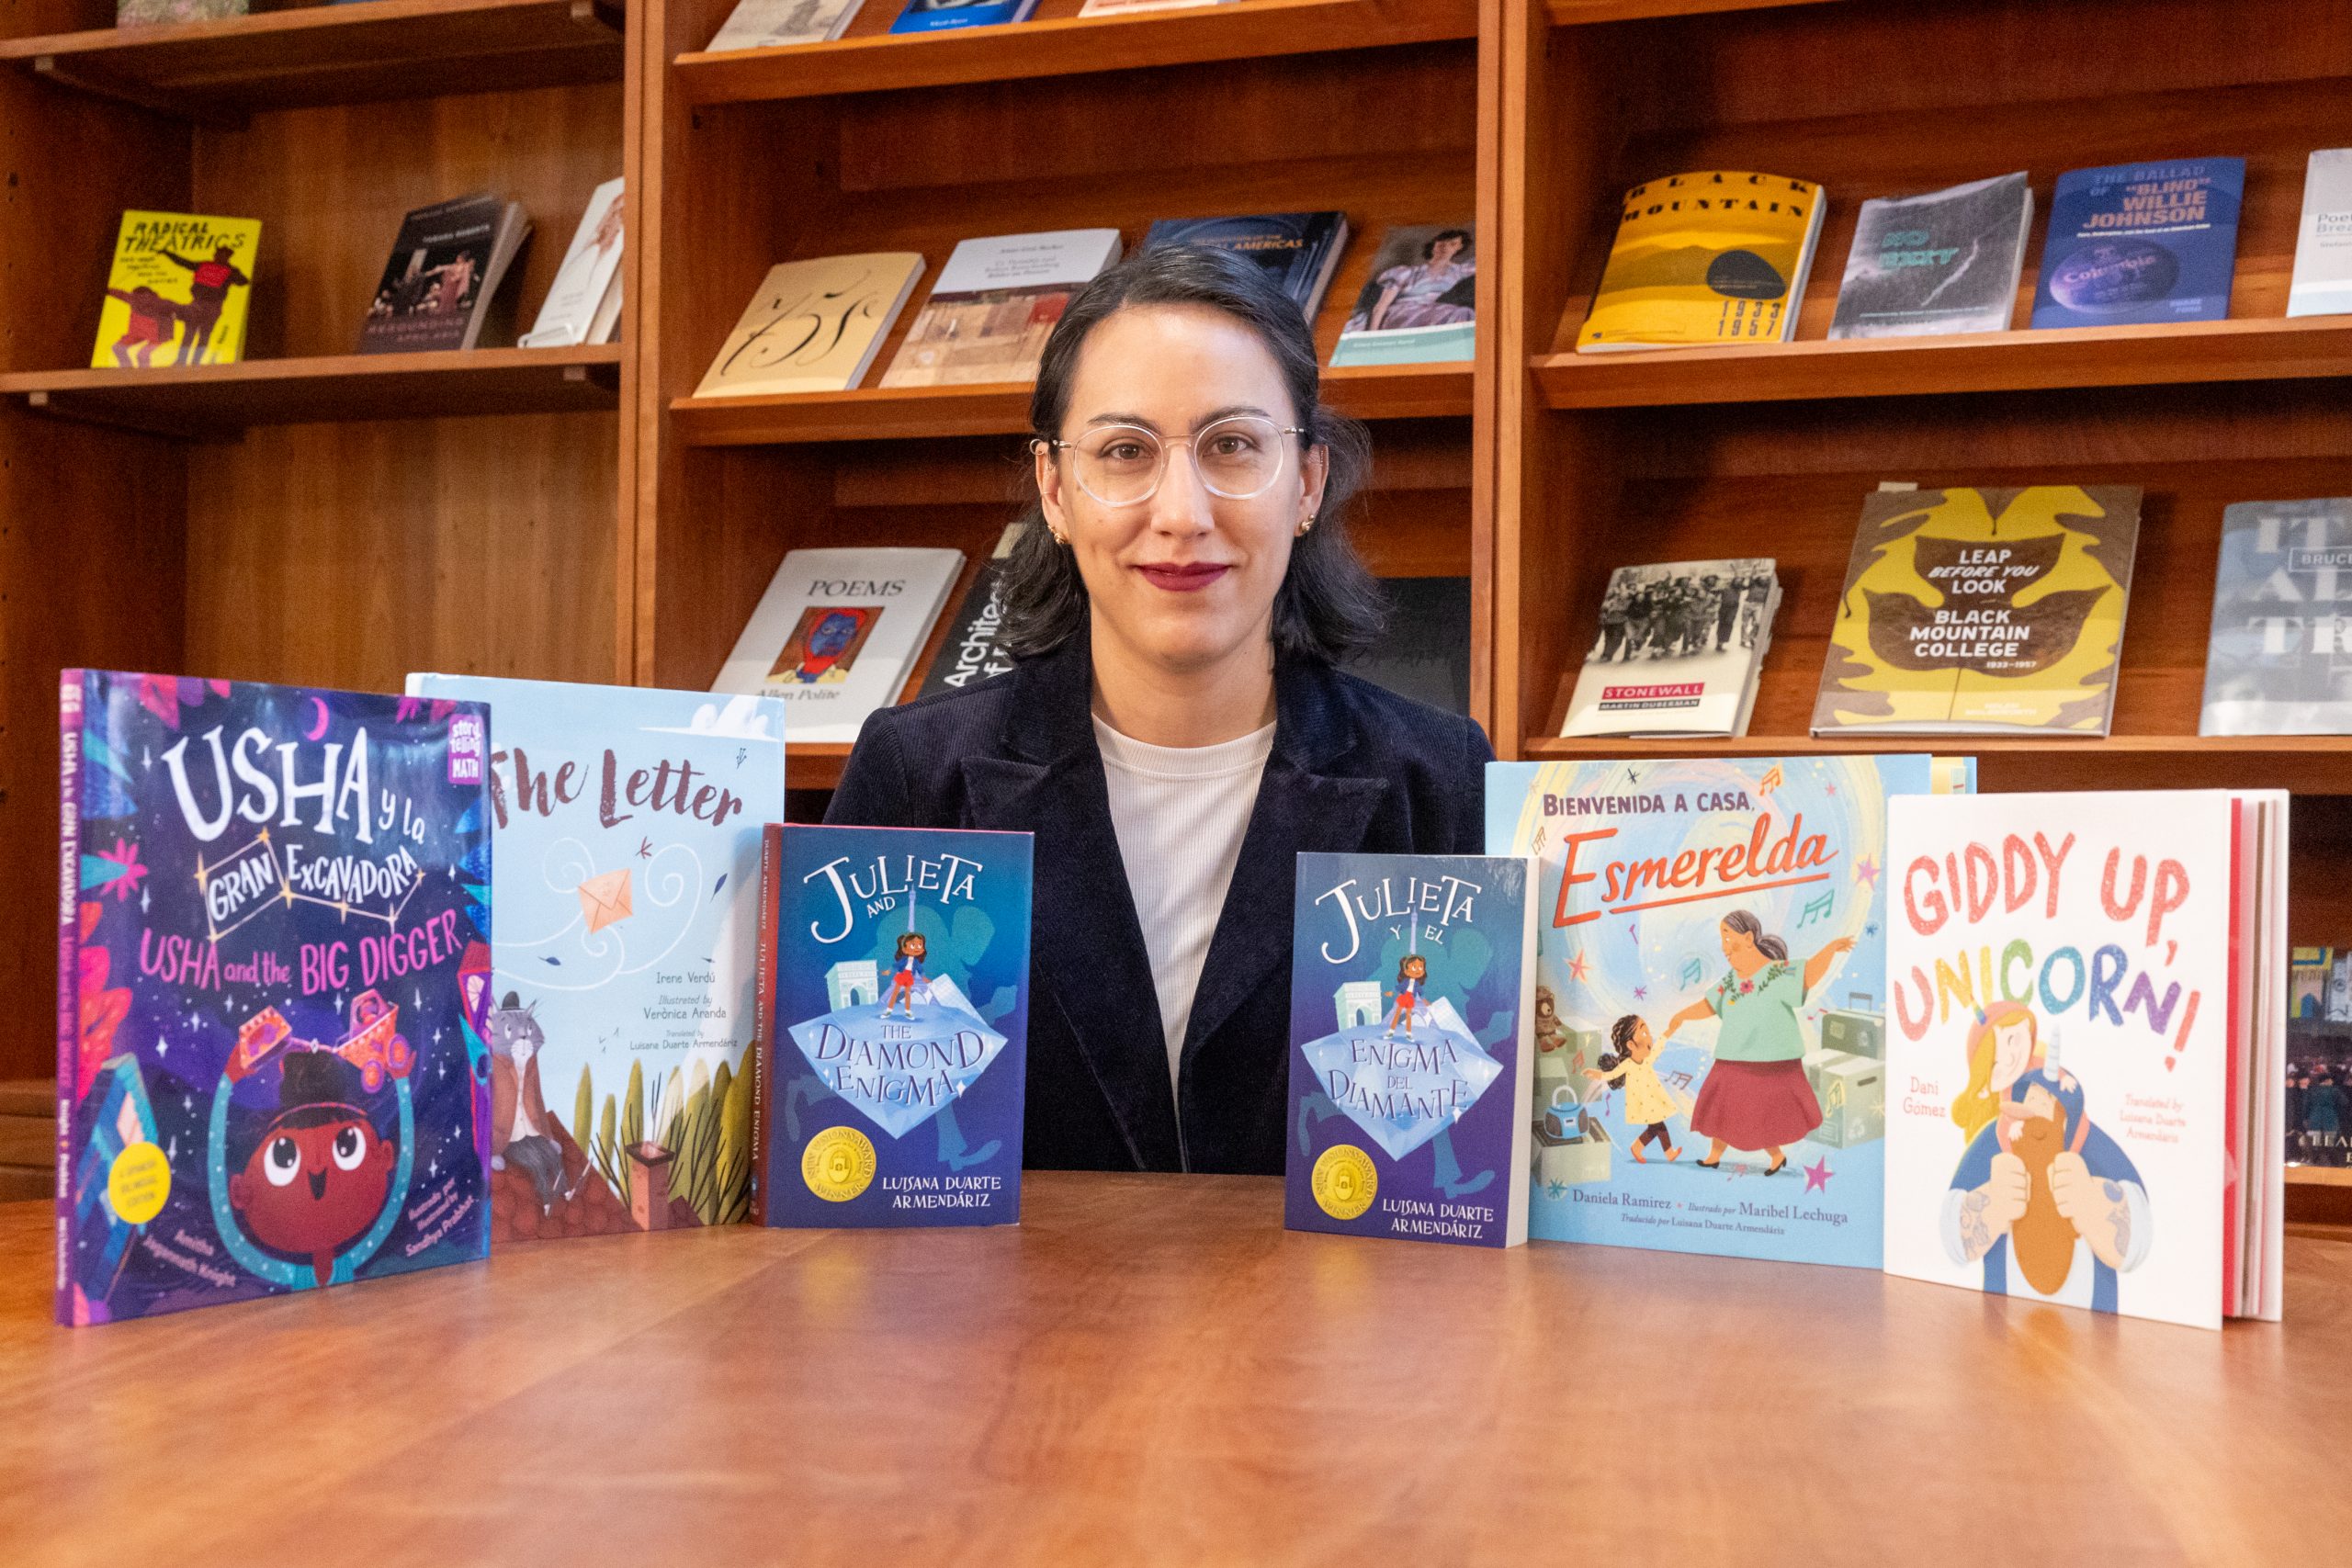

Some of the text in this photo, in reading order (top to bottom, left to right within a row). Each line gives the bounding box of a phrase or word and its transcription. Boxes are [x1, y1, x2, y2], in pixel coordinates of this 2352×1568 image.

[1624, 198, 1804, 221] MOUNTAIN
[2123, 190, 2208, 212] WILLIE
[134, 221, 208, 234] RADICAL
[2083, 206, 2205, 229] JOHNSON
[125, 233, 246, 252] THEATRICS
[1959, 549, 2012, 565] LEAP
[1928, 565, 2040, 578] BEFORE YOU
[808, 580, 906, 597] POEMS
[1951, 579, 2007, 594] LOOK
[1934, 610, 2011, 625] BLACK
[944, 588, 1001, 688] Archite
[1910, 626, 2030, 641] MOUNTAIN
[1915, 642, 2019, 657] COLLEGE
[757, 689, 840, 701] Allen Polite
[1605, 684, 1701, 698] STONEWALL
[1600, 700, 1699, 710] MARTIN DUBERMAN
[453, 758, 479, 778] MATH
[161, 725, 425, 845] USHA y la
[492, 748, 742, 829] The Letter
[1543, 791, 1756, 817] BIENVENIDA A CASA,
[1552, 812, 1839, 929] Esmerelda
[209, 852, 275, 921] GRAN
[803, 852, 984, 944] JULIETA
[866, 896, 896, 919] AND
[1904, 830, 2190, 966] GIDDY UP,
[1315, 874, 1482, 964] JULIETA
[1390, 924, 1443, 945] Y EL
[140, 908, 463, 995] USHA and the BIG DIGGER
[656, 971, 716, 984] Irene Verdú
[658, 995, 713, 1007] Illustrated by
[1894, 938, 2201, 1073] UNICORN!
[692, 1007, 727, 1019] Aranda
[881, 1024, 912, 1039] THE
[662, 1039, 689, 1049] Duarte
[814, 1022, 985, 1070] DIAMOND
[1351, 1038, 1460, 1076] ENIGMA
[754, 1046, 763, 1105] DIAMOND
[836, 1066, 956, 1107] ENIGMA
[1387, 1076, 1413, 1090] DEL
[1910, 1076, 1939, 1095] Dani
[1329, 1069, 1469, 1121] DIAMANTE
[1903, 1096, 1946, 1118] Gómez
[752, 1110, 761, 1161] ENIGMA
[882, 1176, 1001, 1192] LUISANA DUARTE
[892, 1190, 990, 1209] ARMENDÁRIZ
[1383, 1198, 1494, 1223] LUISANA DUARTE
[1572, 1189, 1619, 1205] Daniela
[1688, 1201, 1722, 1214] Ilustrado
[1722, 1207, 1737, 1217] por
[1739, 1201, 1790, 1219] Maribel
[1792, 1206, 1849, 1226] Lechuga
[1391, 1217, 1483, 1239] ARMENDÁRIZ
[1621, 1213, 1785, 1235] Traducido por Luisana Duarte Armendáriz
